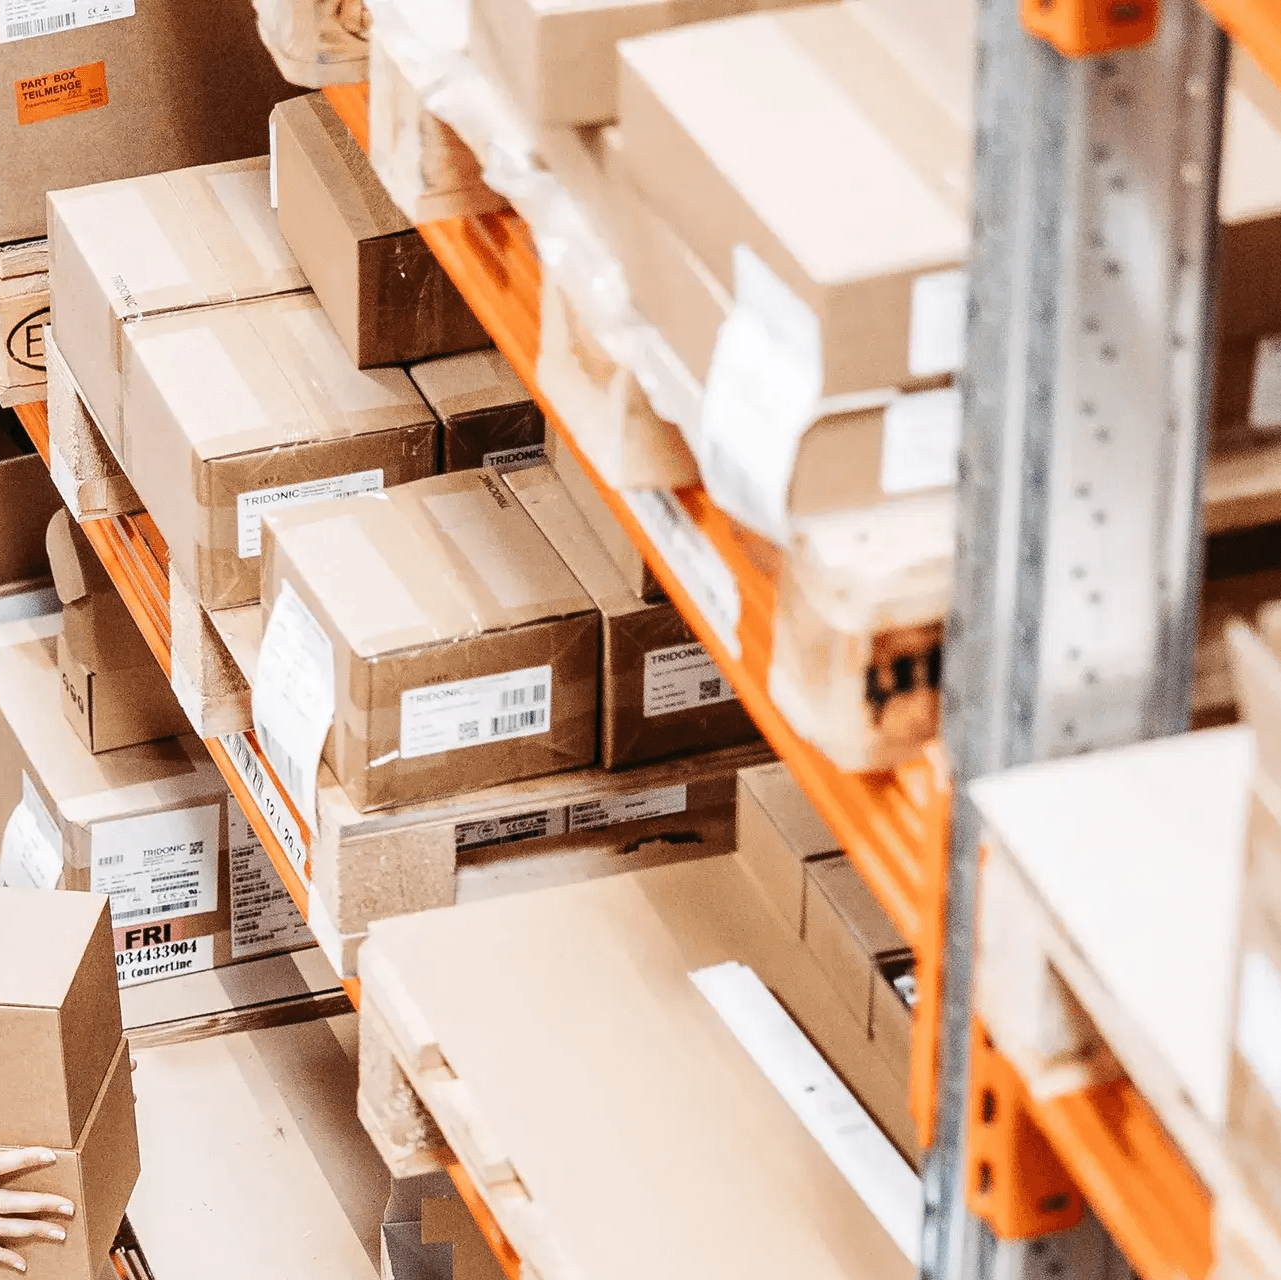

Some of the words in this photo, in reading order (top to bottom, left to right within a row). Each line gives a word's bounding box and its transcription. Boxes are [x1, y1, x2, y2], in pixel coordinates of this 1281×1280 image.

[21, 77, 48, 91] PART
[53, 70, 76, 83] BOX
[23, 80, 82, 101] TEILMENGE
[111, 274, 137, 308] TRIDONIC
[489, 448, 545, 467] TRIDONIC
[244, 488, 301, 507] TRIDONIC
[652, 645, 707, 664] TRIDONIC
[143, 843, 186, 857] TRIDONIC
[125, 923, 171, 950] FRI
